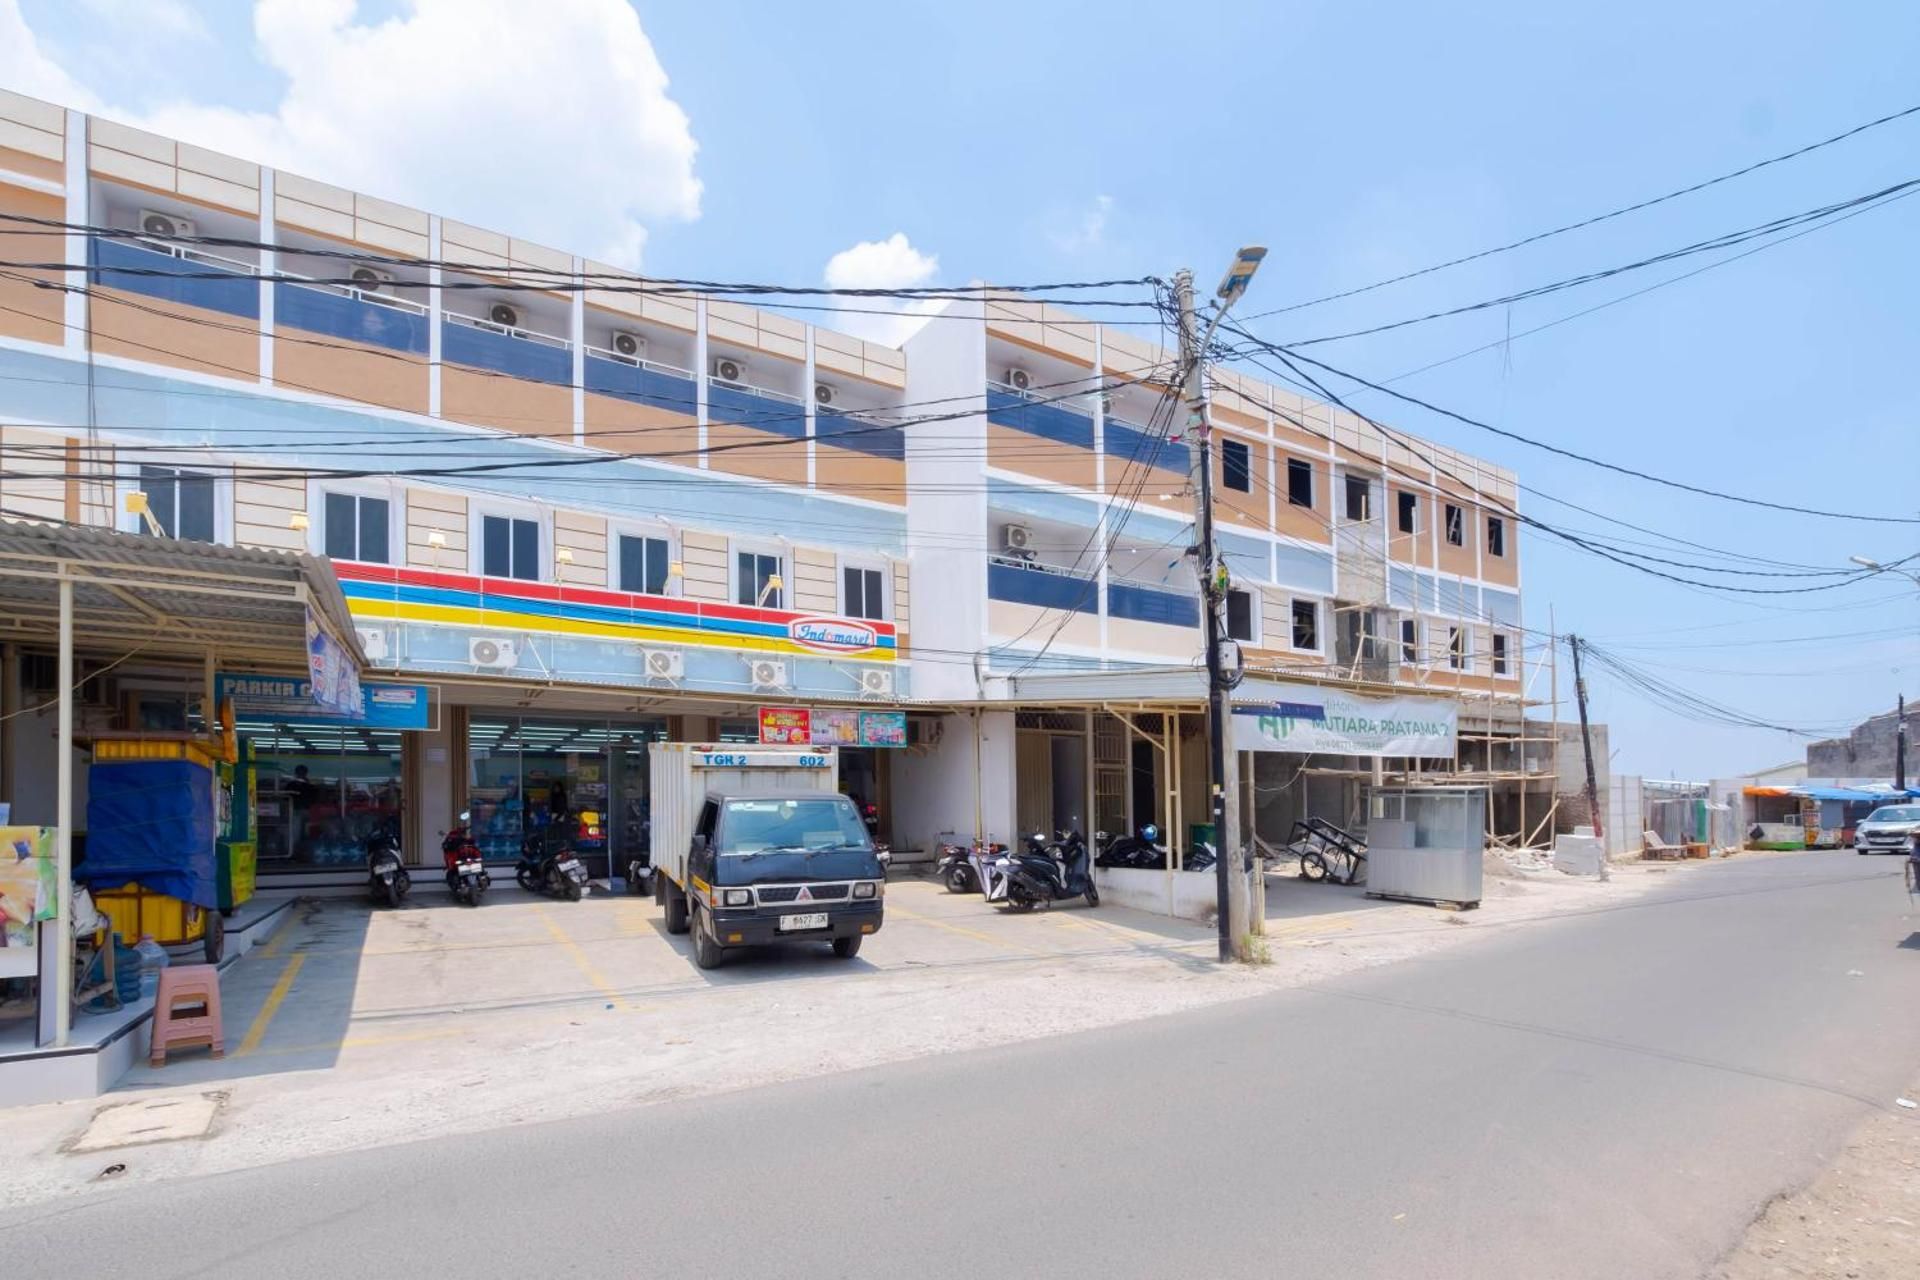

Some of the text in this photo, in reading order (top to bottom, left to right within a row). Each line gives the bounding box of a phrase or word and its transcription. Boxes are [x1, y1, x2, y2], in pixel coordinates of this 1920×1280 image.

[798, 625, 869, 645] Indomaret
[223, 680, 295, 697] PARKIR
[1312, 716, 1377, 735] MUTIARA
[1380, 720, 1441, 736] PRATAMA
[738, 756, 747, 766] 2
[800, 756, 825, 767] 602
